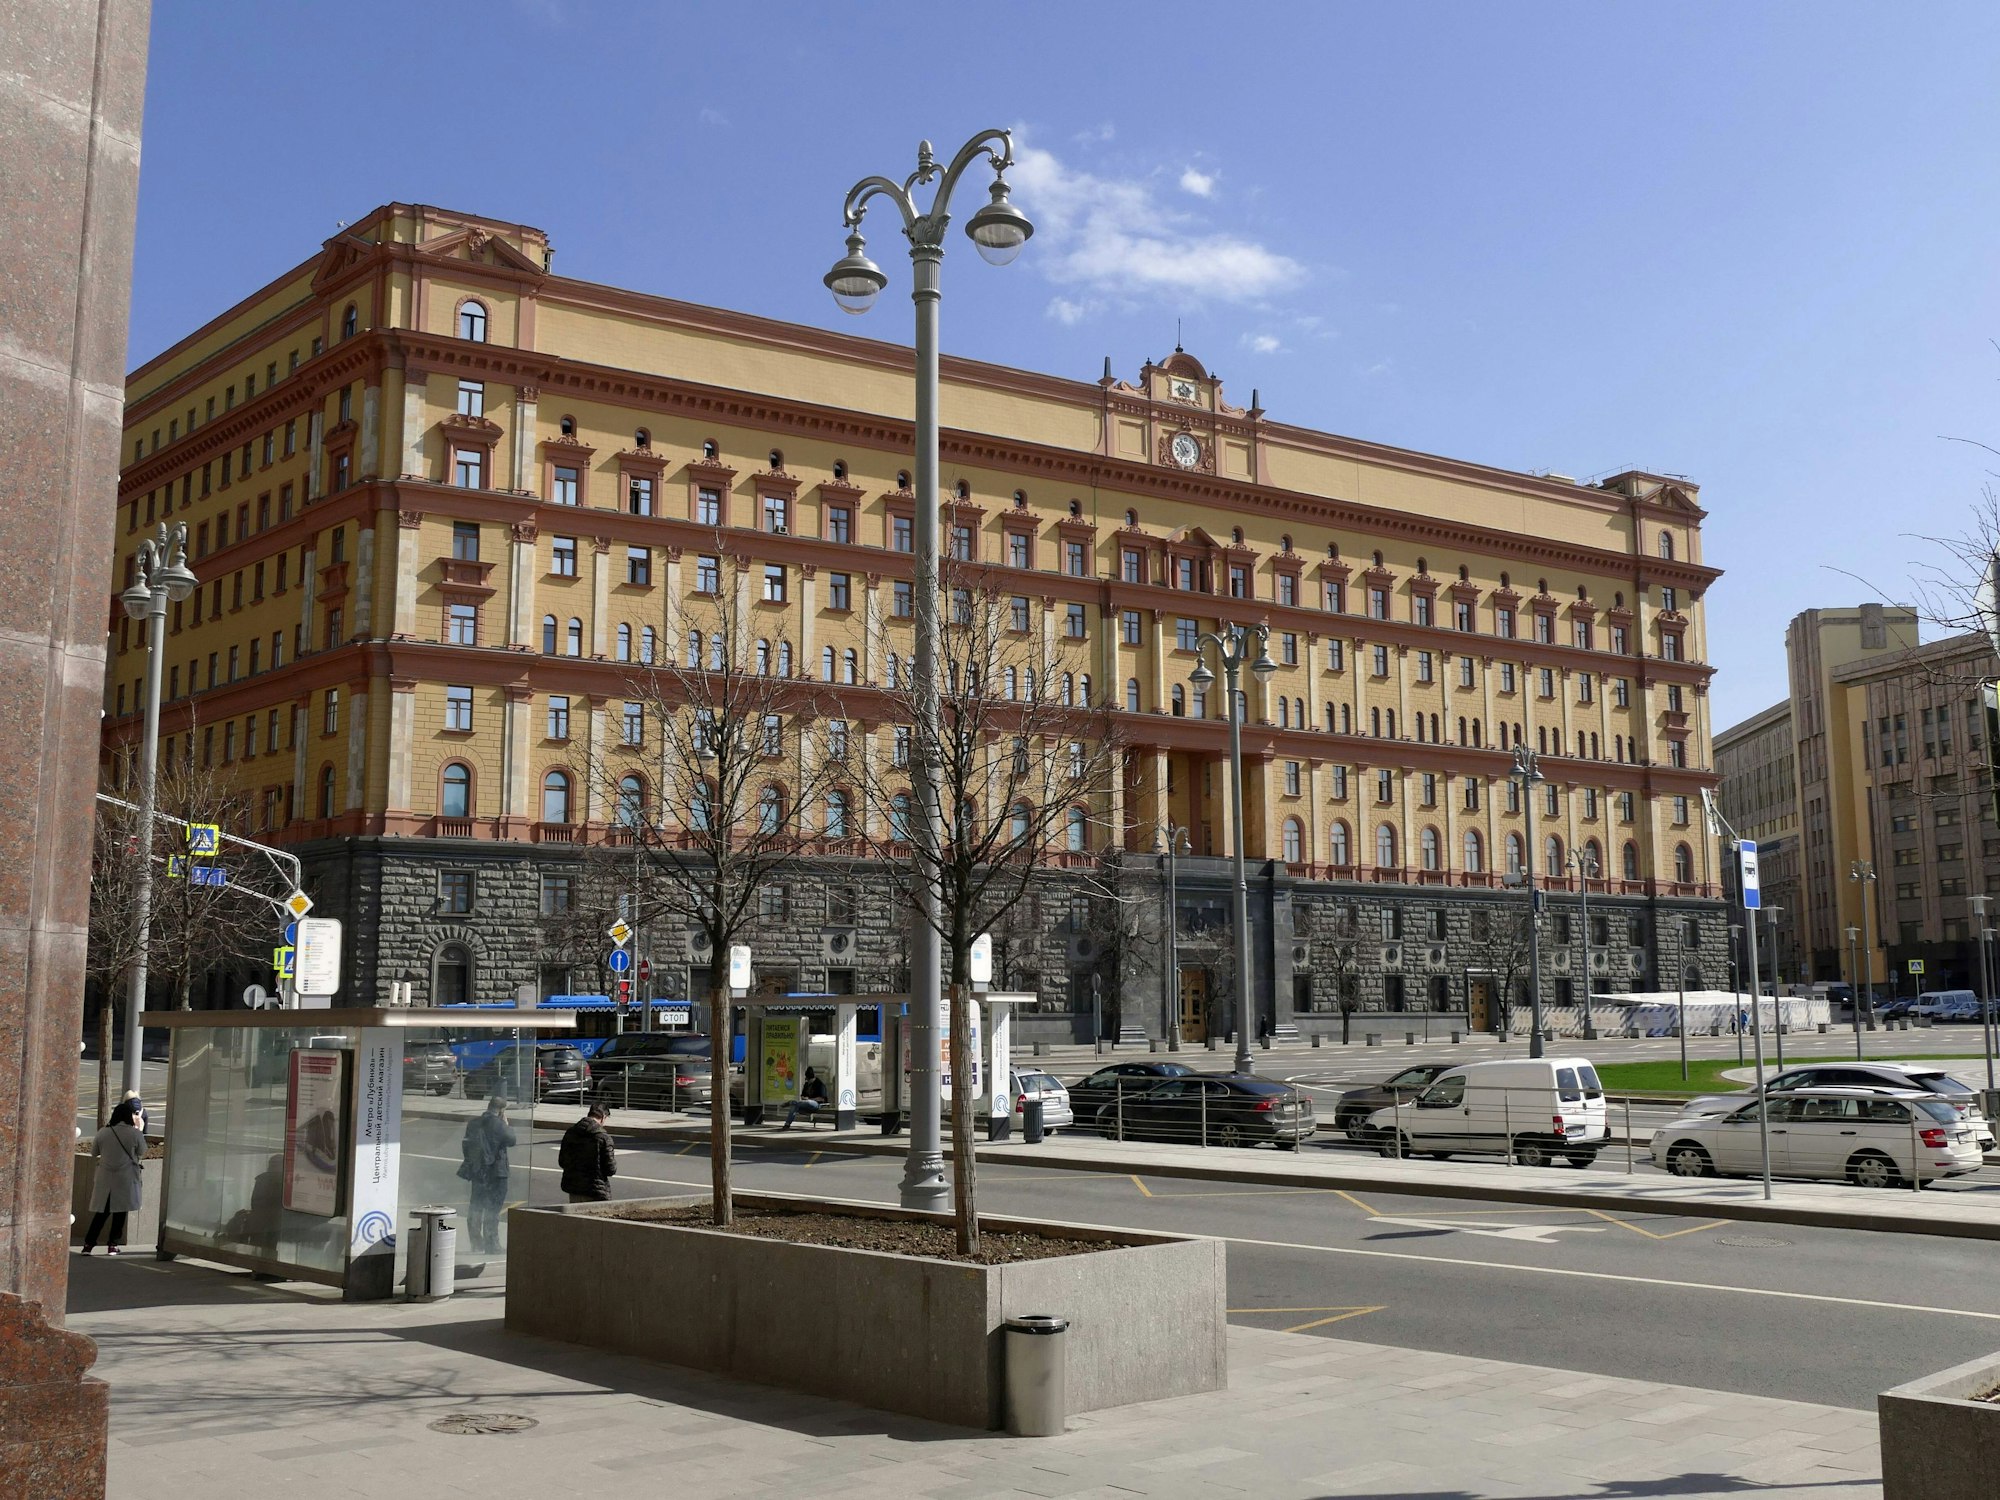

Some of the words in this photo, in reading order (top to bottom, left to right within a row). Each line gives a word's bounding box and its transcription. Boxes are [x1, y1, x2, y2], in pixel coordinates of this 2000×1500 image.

[663, 1014, 685, 1022] СТОП
[367, 1058, 376, 1105] «Лубянка»
[365, 1107, 374, 1138] Метро
[372, 1123, 382, 1184] Центральный
